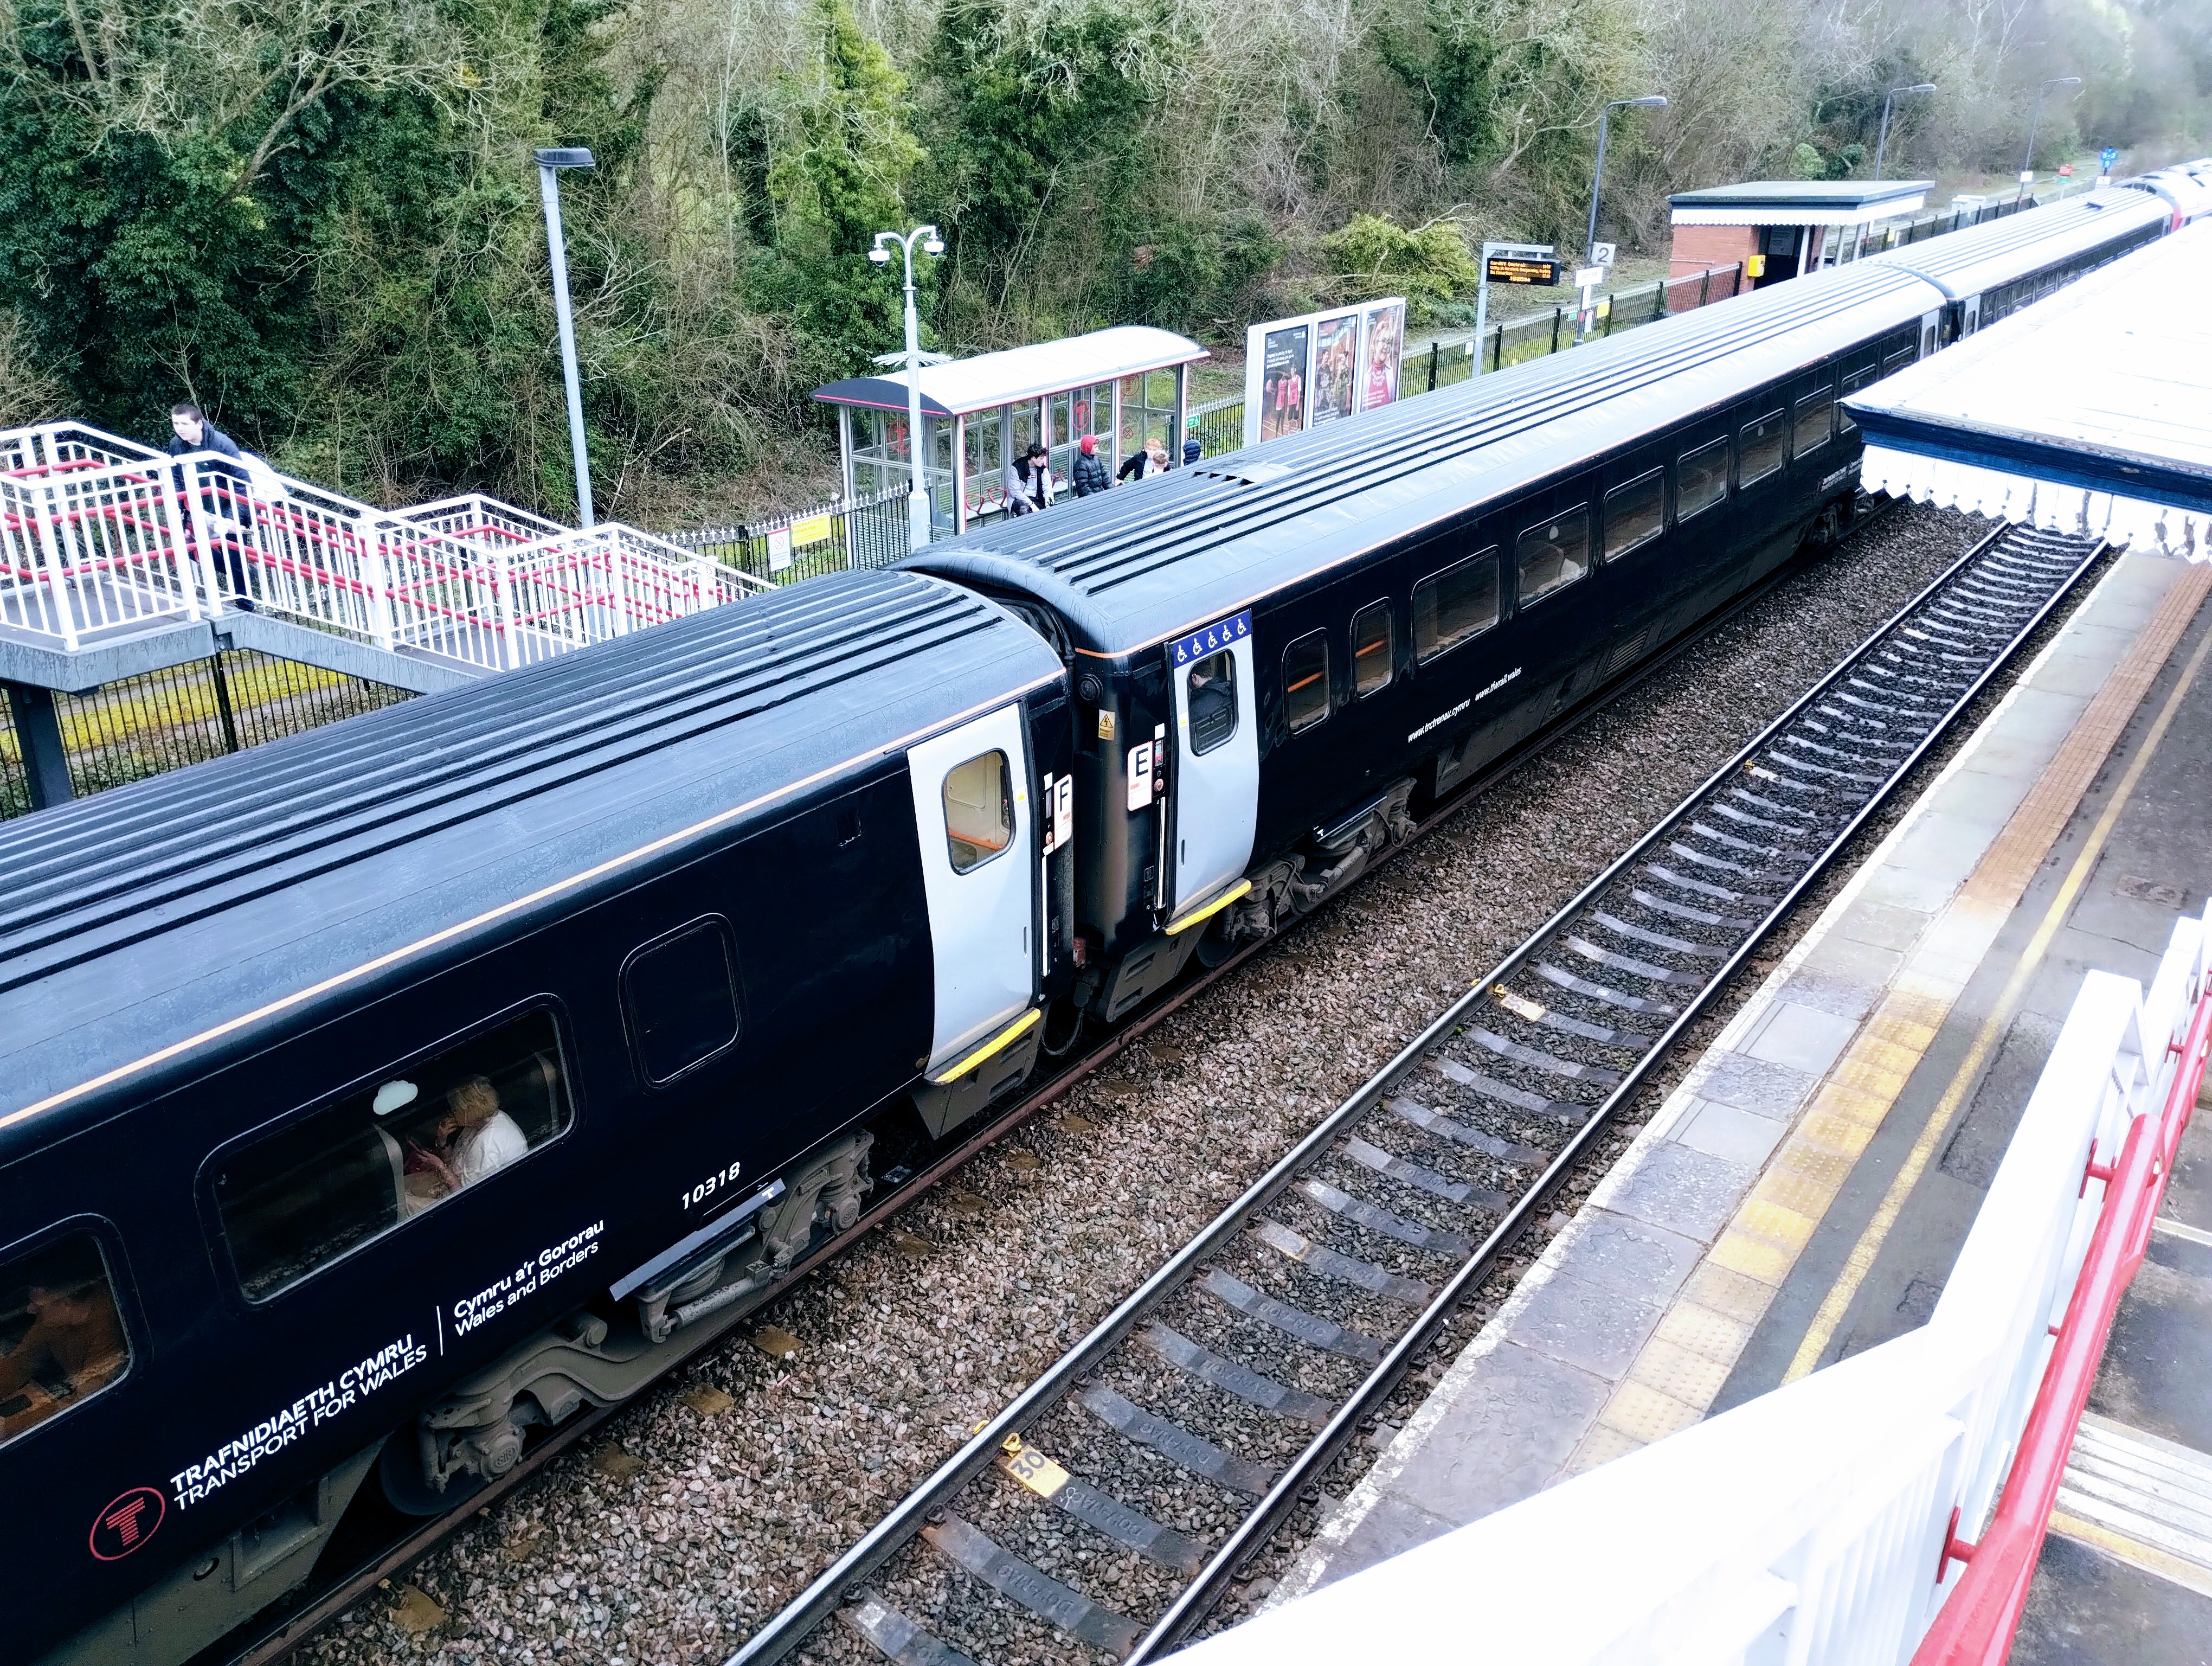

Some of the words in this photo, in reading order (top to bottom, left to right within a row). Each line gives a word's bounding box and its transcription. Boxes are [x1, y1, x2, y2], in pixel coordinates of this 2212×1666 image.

[1597, 247, 1609, 263] 2
[1136, 747, 1149, 777] E
[1060, 779, 1069, 812] F
[681, 1161, 741, 1210] 10318
[454, 1276, 512, 1318] Cymru
[515, 1261, 536, 1282] a'r
[538, 1220, 604, 1266] Gororau
[454, 1300, 504, 1336] Wales
[507, 1276, 536, 1306] and
[540, 1241, 599, 1286] Borders
[170, 1381, 335, 1492] TRAFNIDIAETH
[339, 1334, 413, 1389] CYMRU
[173, 1416, 308, 1510] TRANSPORT
[313, 1389, 356, 1427] FOR
[358, 1344, 427, 1396] WALES
[1011, 1451, 1045, 1479] 30
